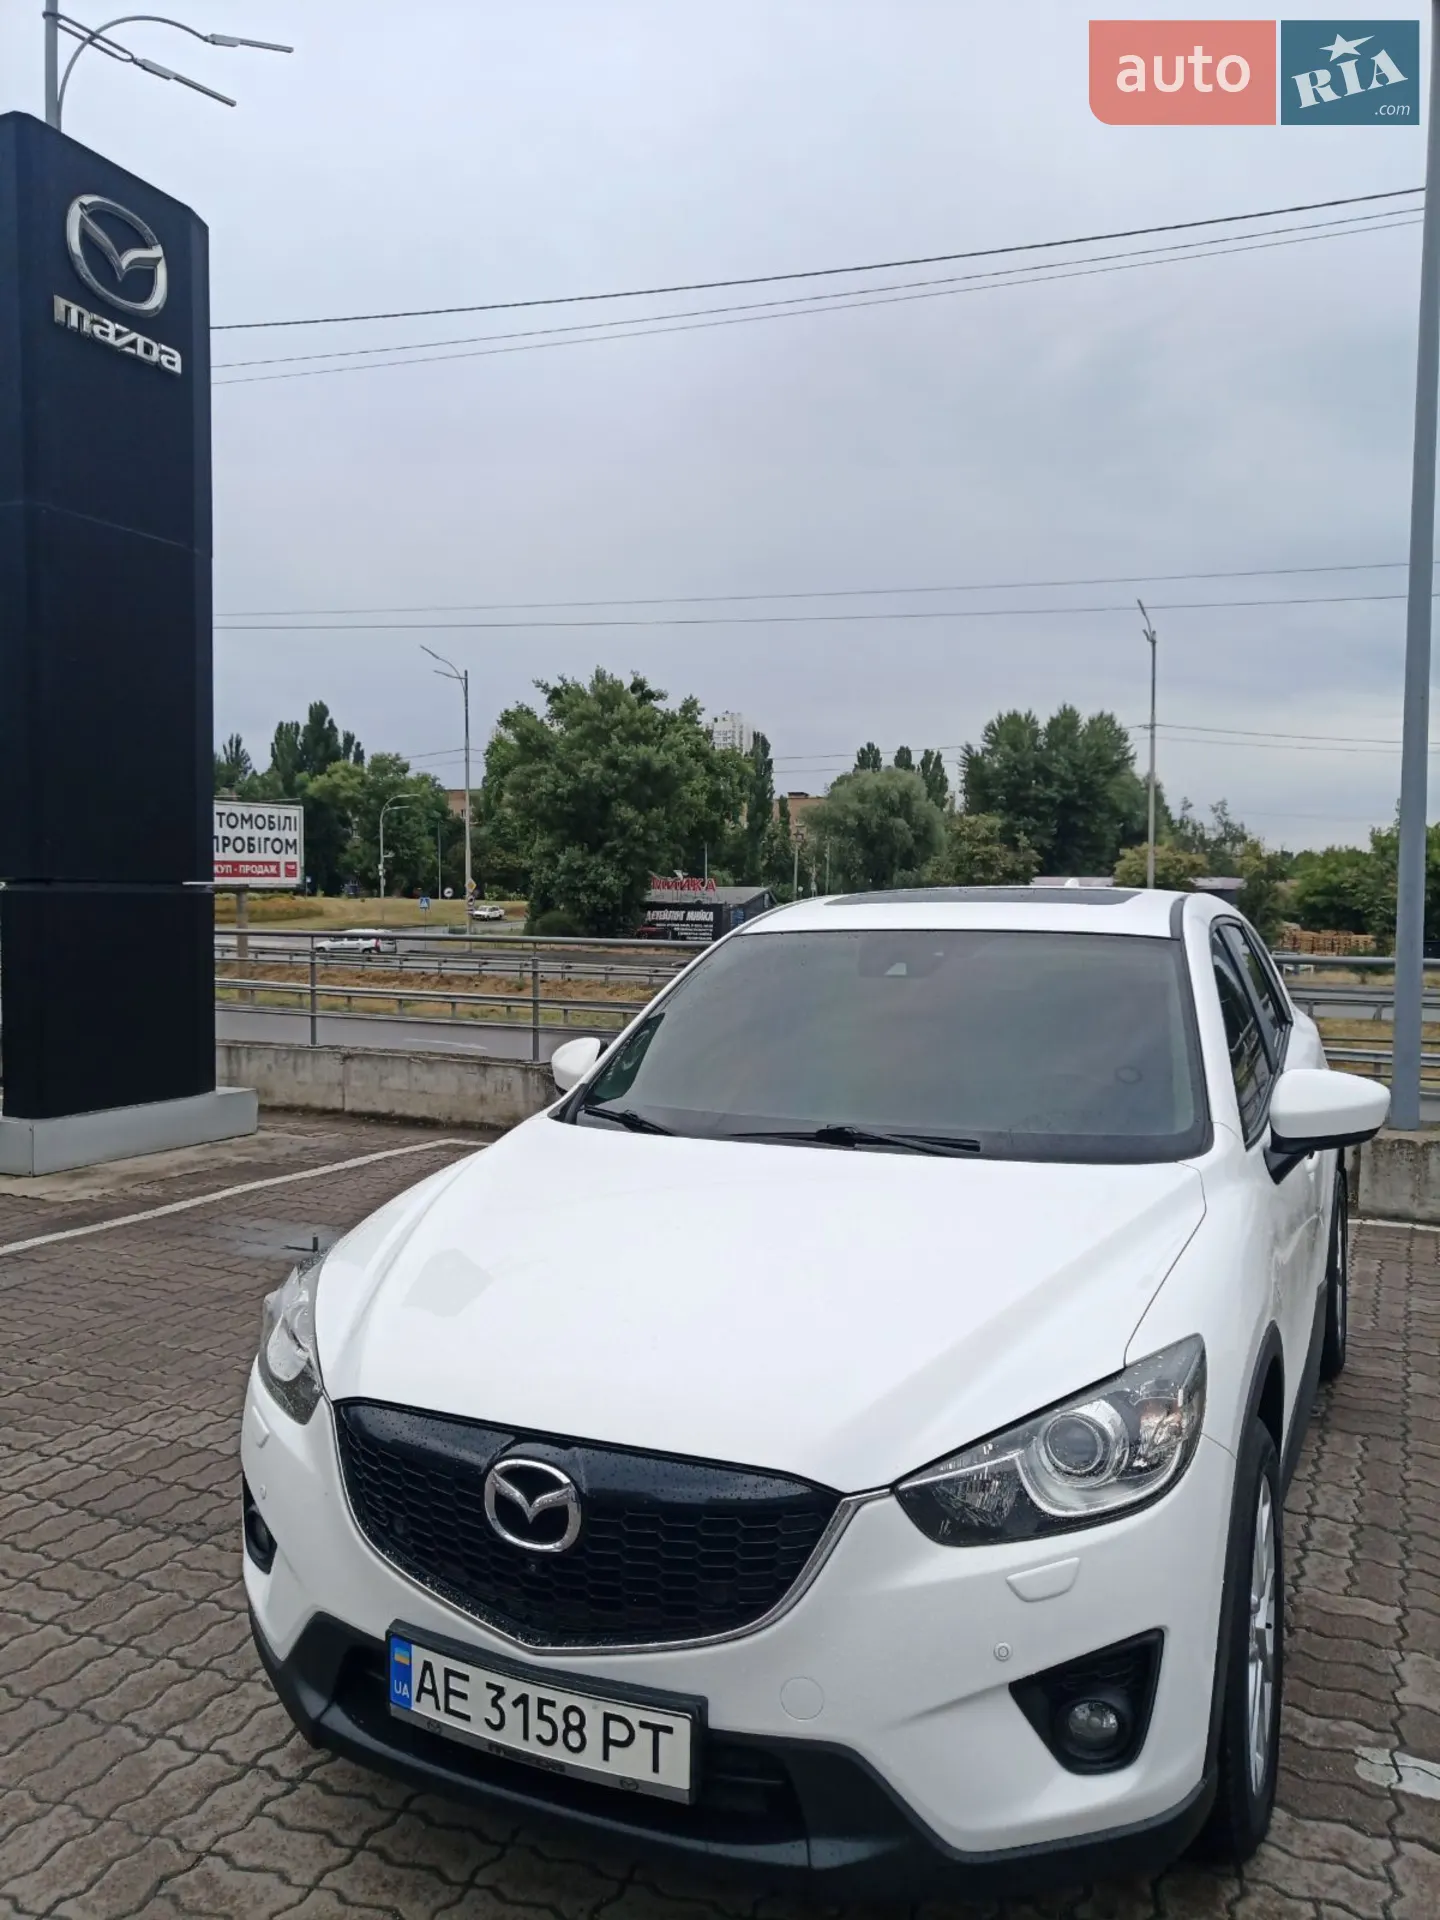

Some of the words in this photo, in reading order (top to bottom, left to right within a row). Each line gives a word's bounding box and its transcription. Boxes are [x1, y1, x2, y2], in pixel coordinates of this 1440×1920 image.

[53, 294, 182, 376] mazda
[216, 812, 297, 831] ТОМОБІЛІ
[239, 864, 277, 874] ПРОДАЖ
[394, 1679, 410, 1699] UA
[415, 1660, 472, 1723] AE
[484, 1682, 587, 1754] 3158
[602, 1711, 674, 1774] PT
